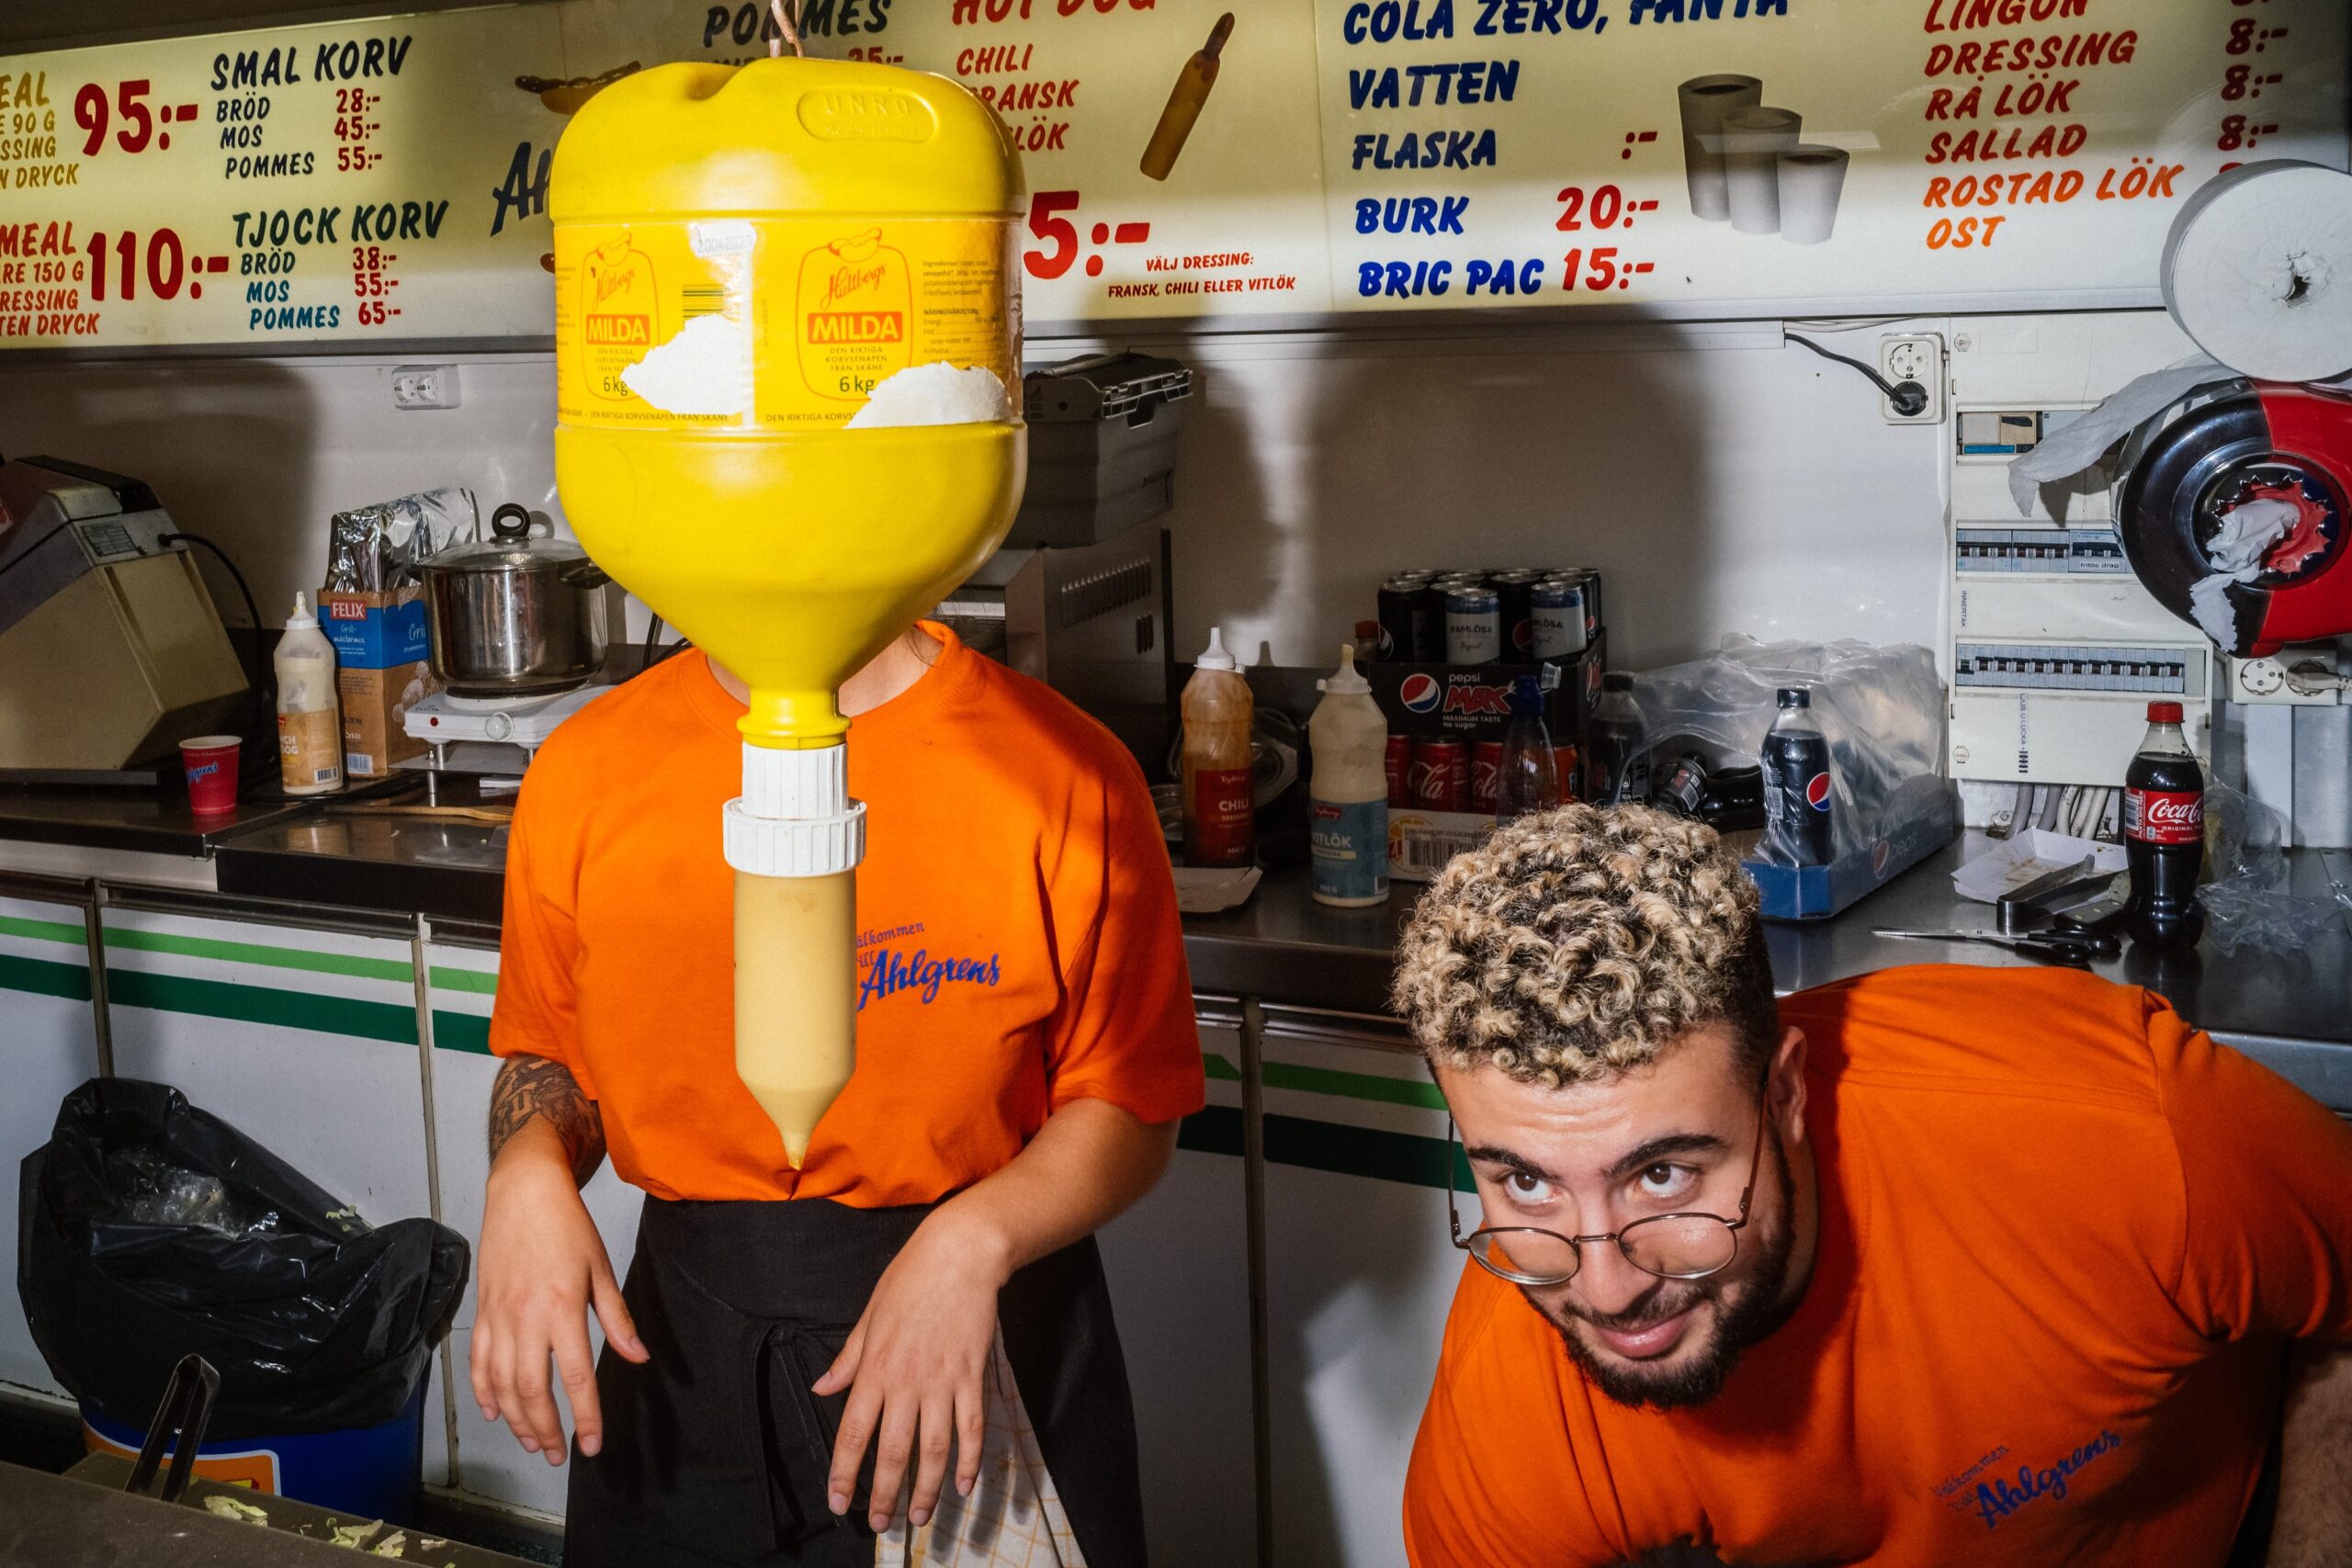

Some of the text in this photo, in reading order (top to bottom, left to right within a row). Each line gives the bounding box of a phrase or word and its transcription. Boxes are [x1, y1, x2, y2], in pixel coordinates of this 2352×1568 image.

[1343, 0, 1453, 44] COLA
[1473, 0, 1608, 35] ZERO,
[1924, 0, 2088, 33] LINGON
[210, 35, 413, 91] SMAL KORV
[956, 43, 1034, 76] CHILI
[1925, 18, 2289, 77] DRESSING 8:-
[967, 80, 1080, 111] RANSK
[1349, 60, 1520, 109] VATTEN
[1925, 64, 2283, 120] RÅ LÖK 8:-
[74, 79, 198, 156] 95:-
[216, 87, 381, 123] BRÖD 28:-
[13, 112, 36, 134] 90
[44, 109, 55, 132] G
[220, 115, 380, 150] MOS 45:-
[1007, 116, 1069, 151] LÖK
[1352, 130, 1496, 170] FLASKA
[1925, 115, 2279, 164] SALLAD 8:-
[16, 163, 79, 189] DRYCK
[225, 145, 383, 180] POMMES 55:-
[1923, 157, 2185, 208] ROSTAD LÖK
[232, 199, 449, 248] TJOCK KORV
[1355, 185, 1659, 236] BURK 20:-
[1926, 216, 2006, 250] OST
[0, 260, 84, 284] RE 150 G
[86, 228, 229, 301] 110:-
[241, 246, 397, 276] BRÖD 38:-
[1147, 252, 1254, 272] VÄLJ DRESSING:
[1358, 247, 1654, 299] BRIC PAC 15:-
[246, 272, 398, 303] MOS 55:-
[1108, 274, 1295, 298] FRANSK, CHILI ELLER VITLÖK
[37, 312, 100, 335] DRYCK
[250, 305, 340, 331] POMMES
[588, 317, 647, 343] MILDA
[812, 315, 899, 342] MILDA
[604, 375, 628, 397] 6 kg
[839, 375, 876, 395] 6 kg
[602, 411, 624, 420] RIKTIGA
[626, 412, 675, 422] KORVSENAPEN
[766, 414, 785, 423] DEN
[787, 413, 823, 422] RIKTIGA
[333, 602, 364, 618] FELIX
[1449, 672, 1481, 683] pepsi
[1442, 684, 1512, 716] MAX
[1443, 715, 1478, 723] MAXIMUM
[1454, 722, 1476, 730] sugar
[856, 950, 876, 968] ill
[857, 949, 1001, 1012] Ahlgrens
[1977, 1428, 2122, 1529] Ahlgrens
